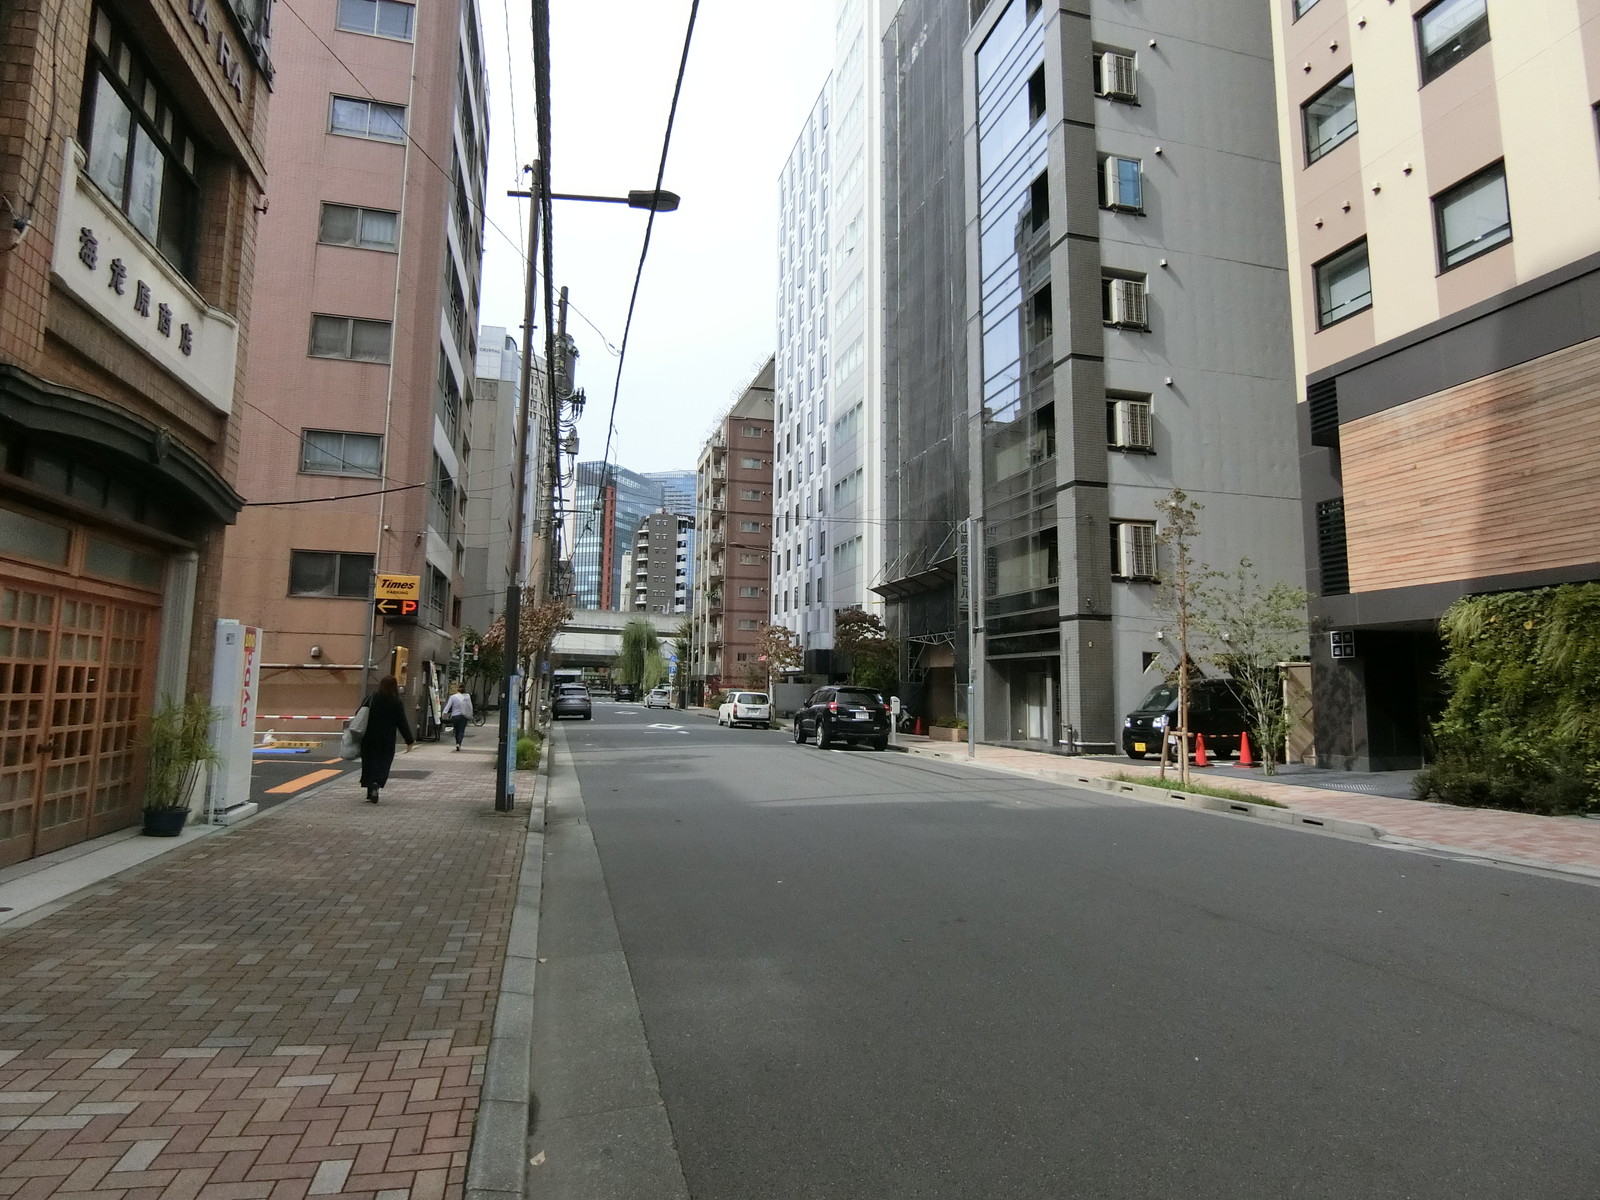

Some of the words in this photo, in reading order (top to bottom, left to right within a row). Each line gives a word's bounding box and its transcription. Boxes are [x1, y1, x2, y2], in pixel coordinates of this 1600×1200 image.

[187, 0, 242, 103] ARA
[79, 226, 193, 356] 海老原商店
[381, 579, 415, 589] Times
[401, 600, 416, 615] P
